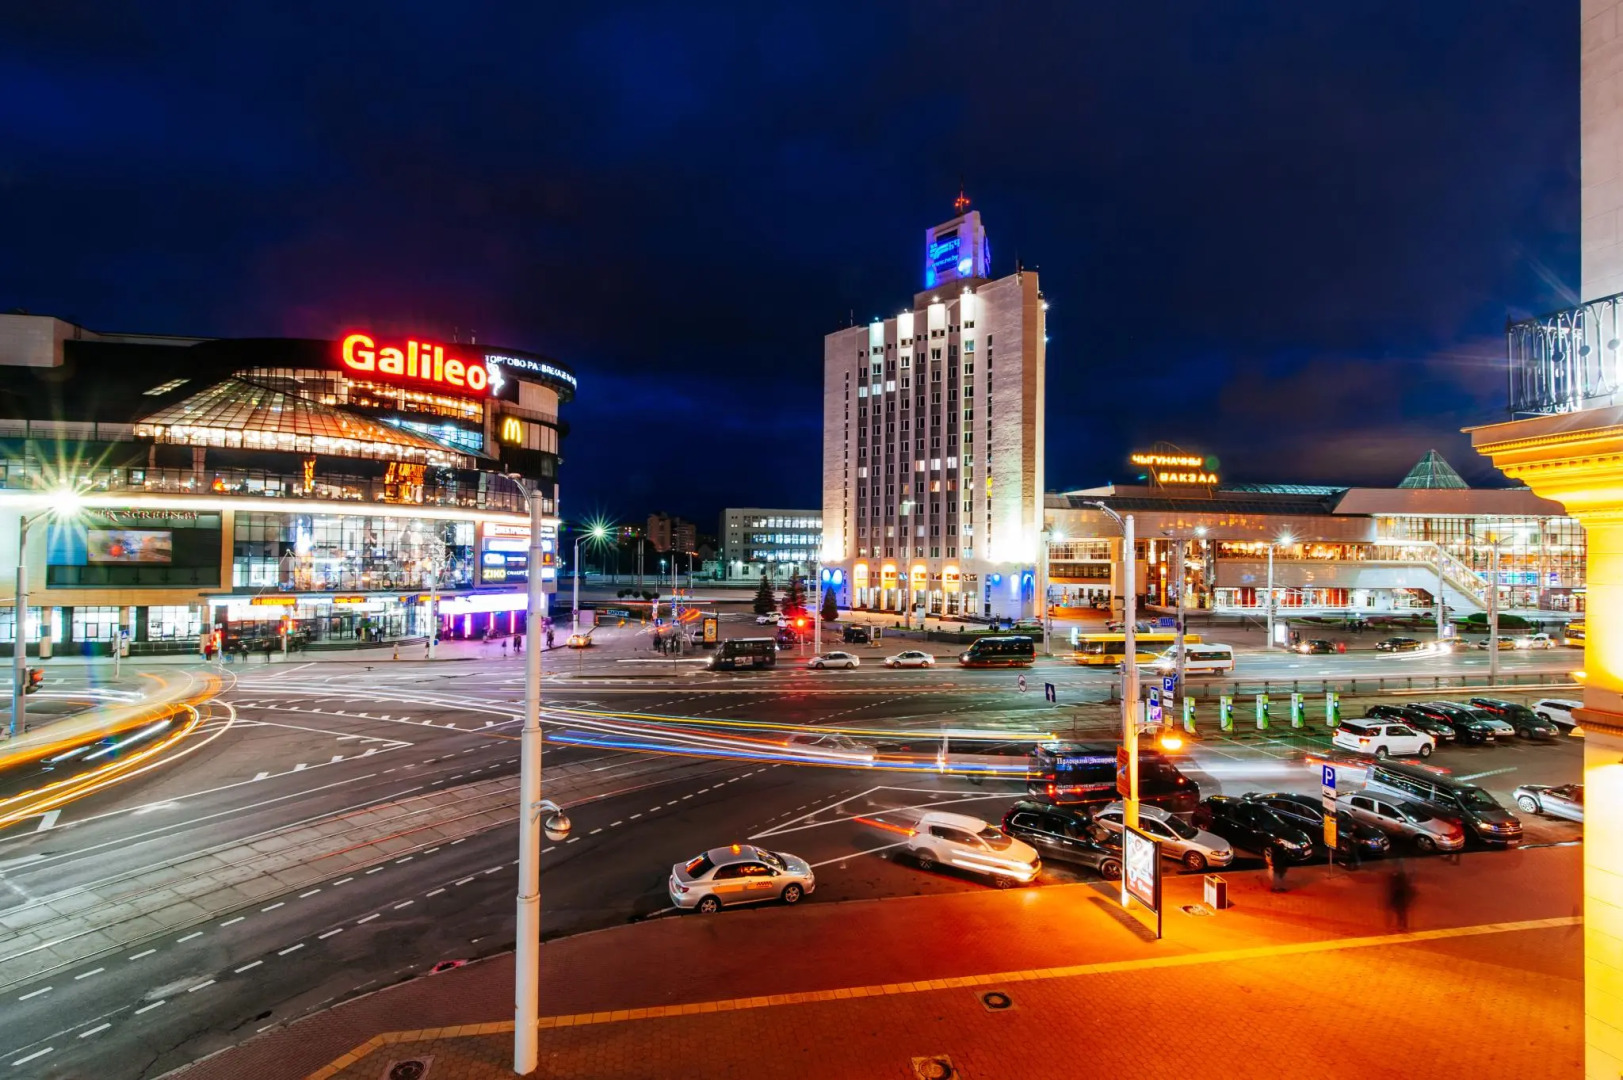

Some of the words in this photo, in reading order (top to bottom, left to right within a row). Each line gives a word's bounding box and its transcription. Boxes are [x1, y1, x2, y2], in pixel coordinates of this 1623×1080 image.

[342, 333, 487, 391] Galileo
[1131, 454, 1202, 467] ЧЫГУНАЧНЫ
[1159, 472, 1218, 484] ВАКЗАЛ
[482, 568, 506, 580] ZIKO
